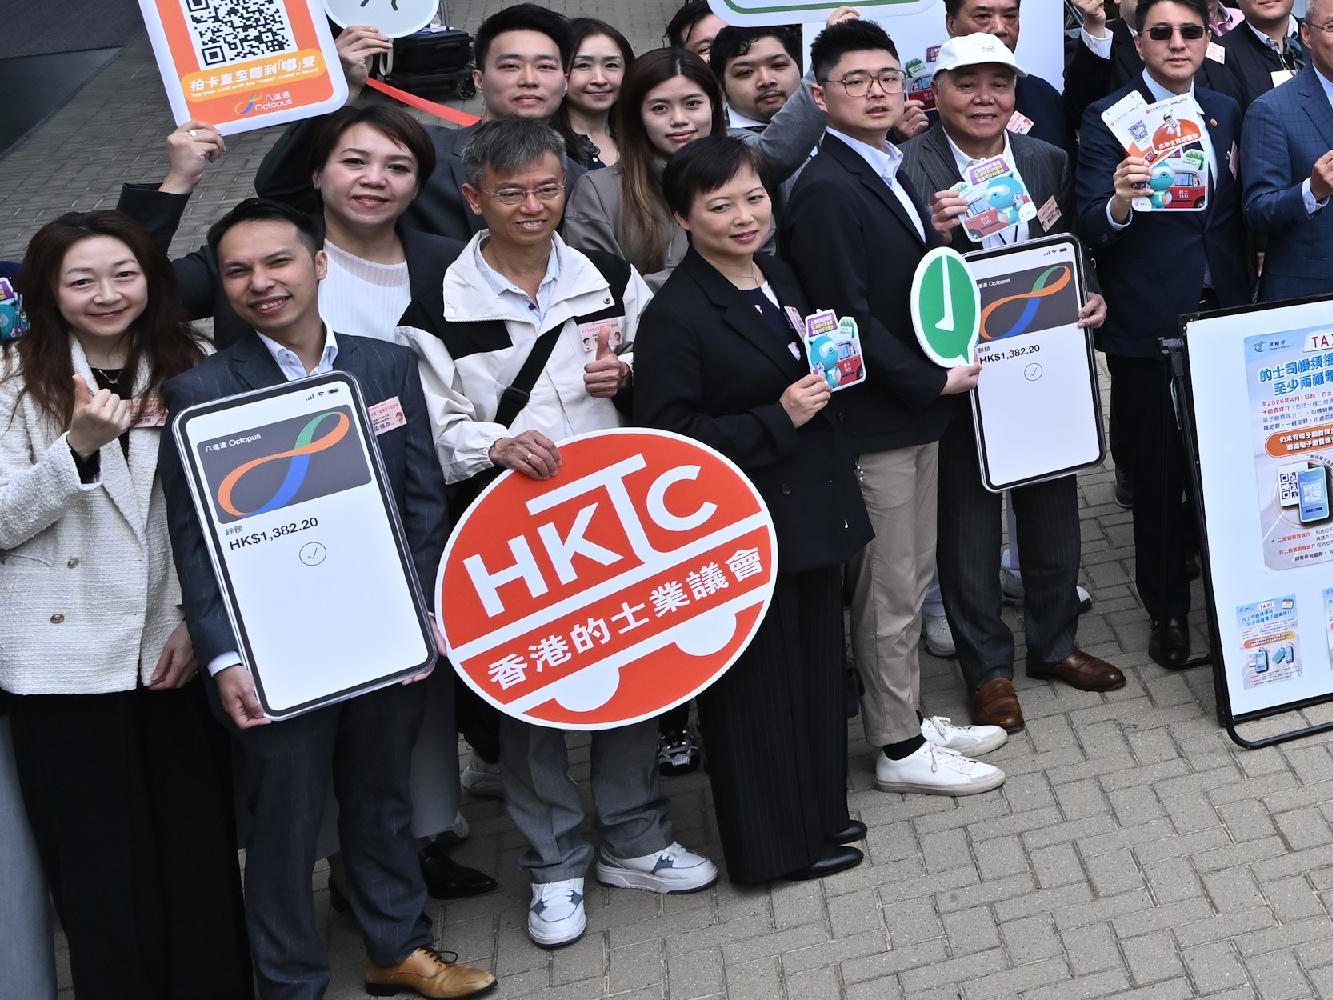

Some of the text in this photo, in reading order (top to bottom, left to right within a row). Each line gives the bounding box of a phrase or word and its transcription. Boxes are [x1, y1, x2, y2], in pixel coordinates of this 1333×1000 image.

[255, 99, 293, 111] Octopus
[979, 344, 1040, 365] HK$1,382.20
[229, 433, 262, 447] Octopus
[229, 516, 319, 551] HK$1,382.20
[463, 453, 718, 619] HKTC
[487, 546, 764, 690] 香港的士業議會
